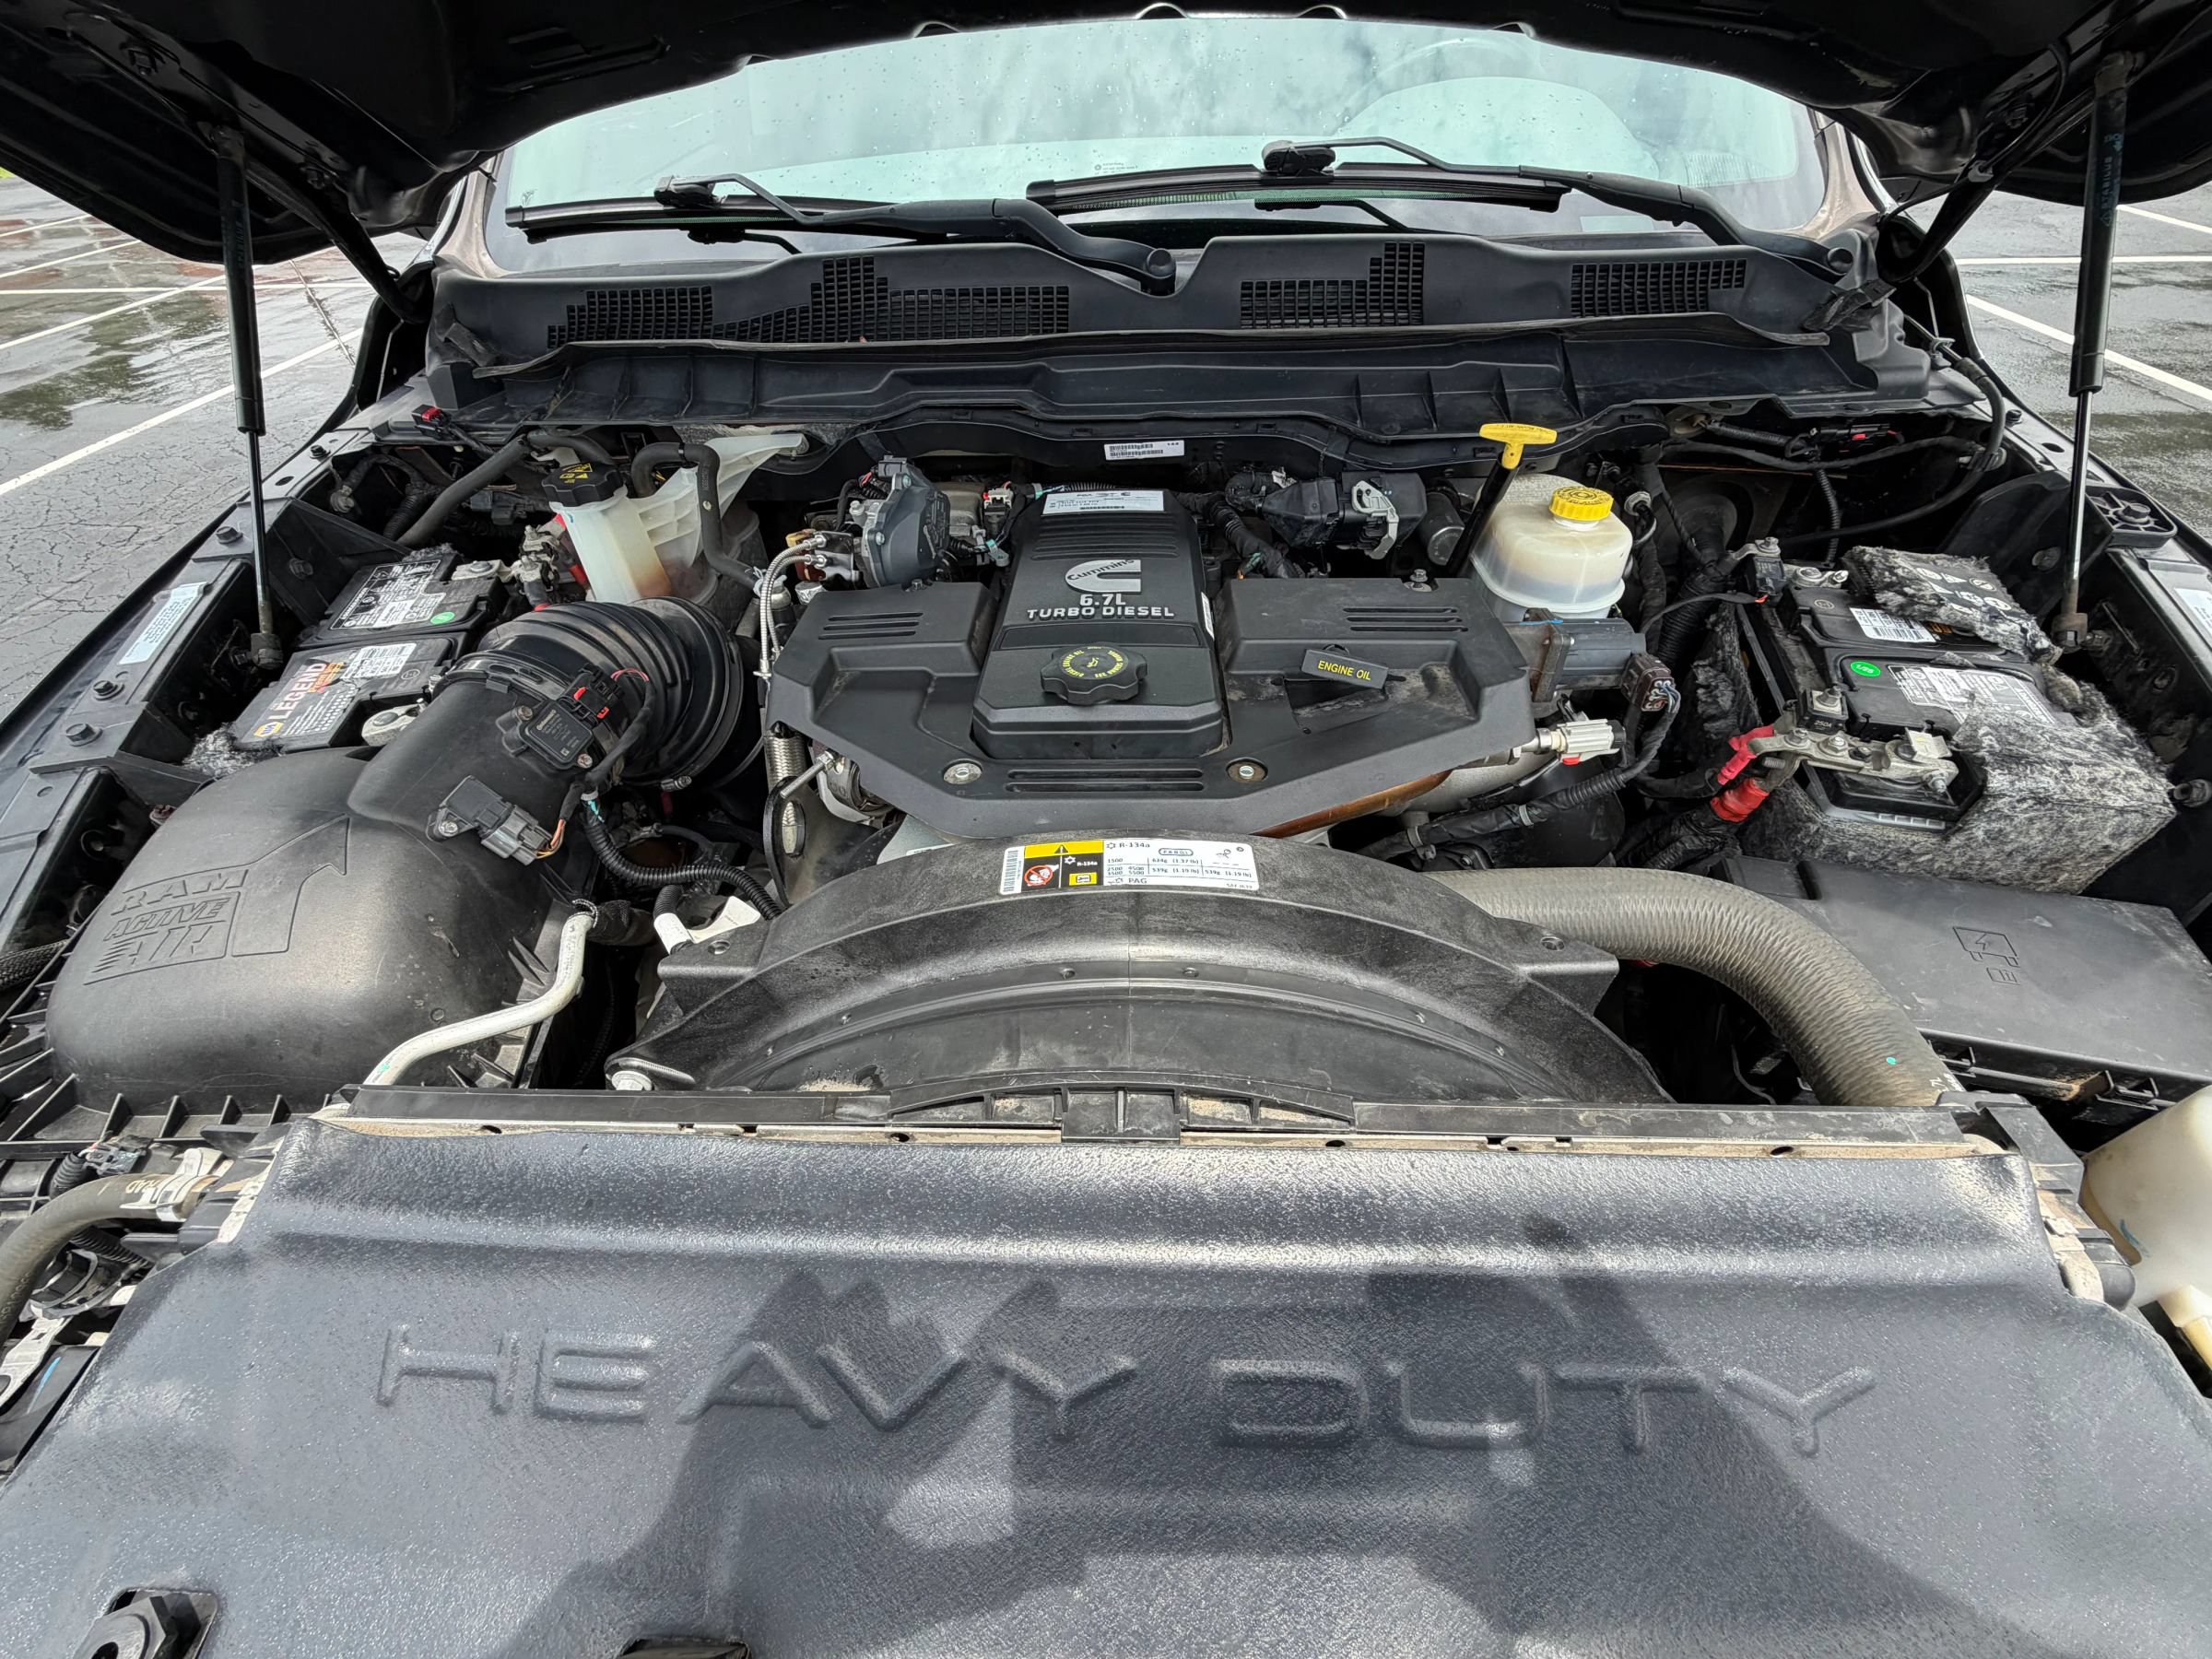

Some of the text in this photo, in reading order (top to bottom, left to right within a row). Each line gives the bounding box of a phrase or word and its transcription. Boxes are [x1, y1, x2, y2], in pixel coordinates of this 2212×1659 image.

[1066, 559, 1135, 581] Cummins
[1027, 606, 1175, 619] TURBO DIESEL
[1079, 593, 1126, 606] 6.7L
[267, 663, 327, 721] LEGEND
[1317, 660, 1371, 681] ENGINE OIL
[111, 869, 249, 916] RAM
[103, 897, 232, 941] ACTIVE
[92, 924, 212, 973] AIR
[375, 1324, 1877, 1458] HEAVY DUTY
